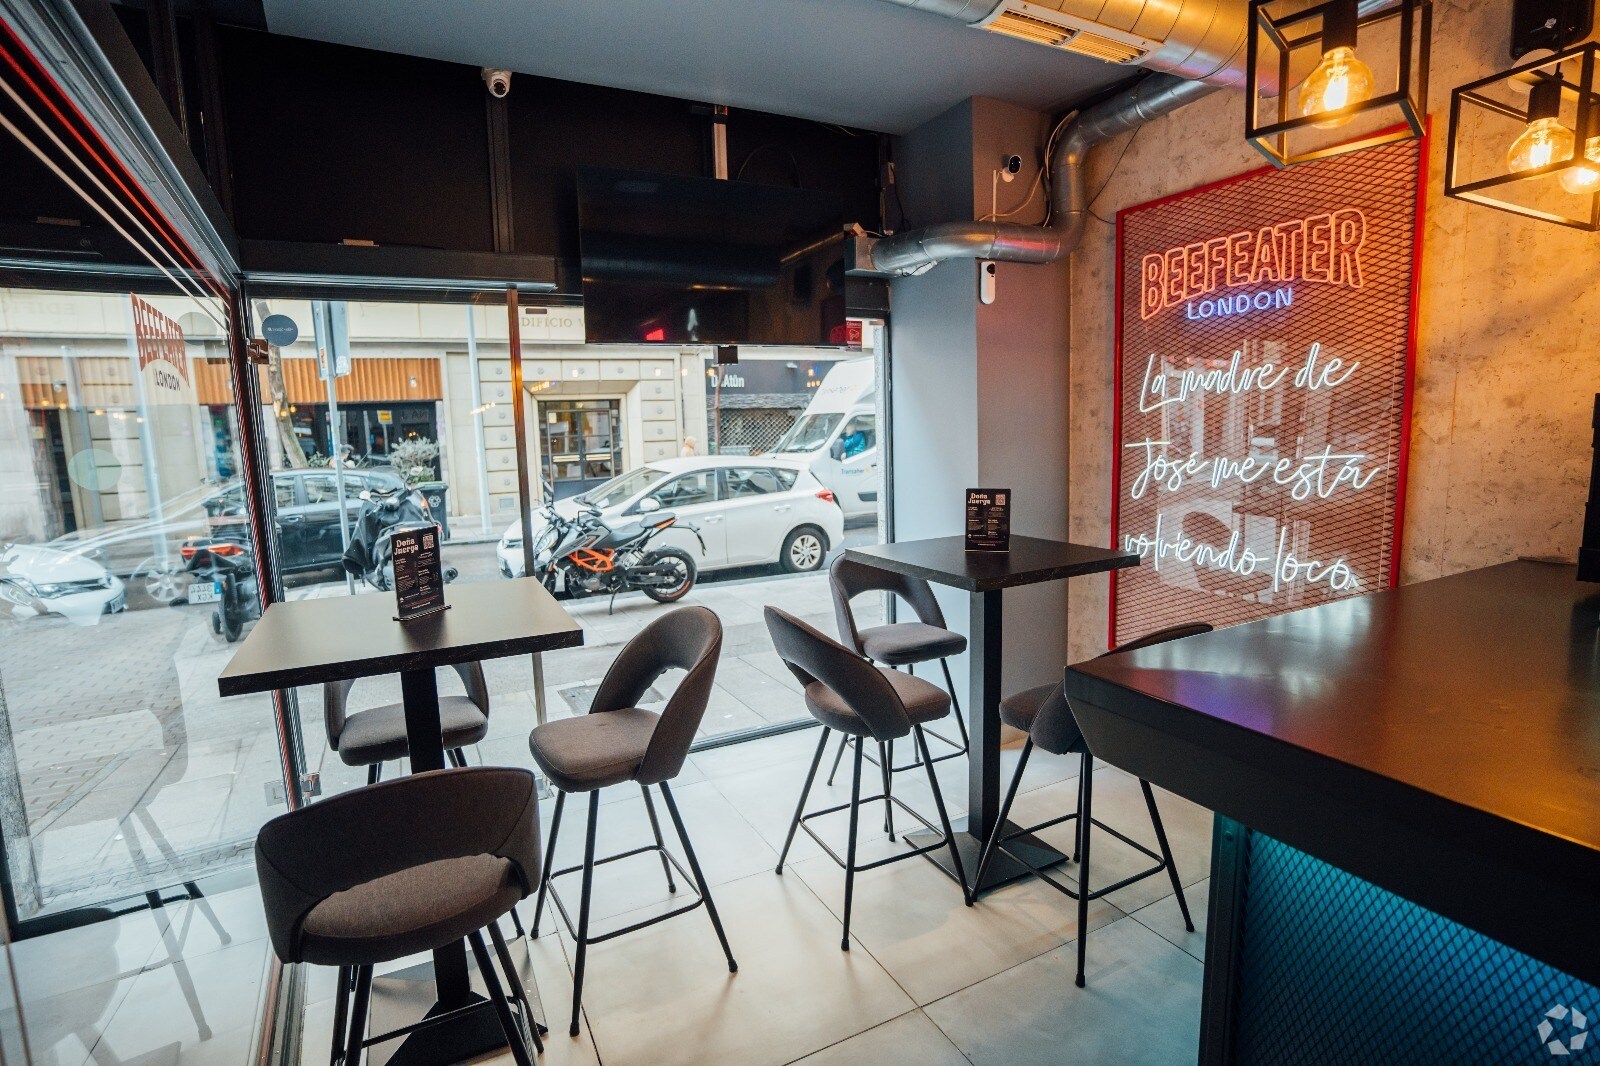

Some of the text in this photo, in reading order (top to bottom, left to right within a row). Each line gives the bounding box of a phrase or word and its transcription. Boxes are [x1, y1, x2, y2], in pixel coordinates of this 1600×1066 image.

[1141, 208, 1367, 321] BEEFEATER
[521, 316, 573, 328] DIFICIO
[1187, 287, 1293, 321] LONDON
[130, 292, 190, 388] BEEFEATER
[154, 368, 181, 391] LONDON
[1140, 342, 1361, 412] La madre de
[1125, 438, 1381, 500] José me está
[394, 544, 419, 556] Juerga
[396, 537, 415, 548] Doña
[1125, 514, 1350, 592] volviendo loco
